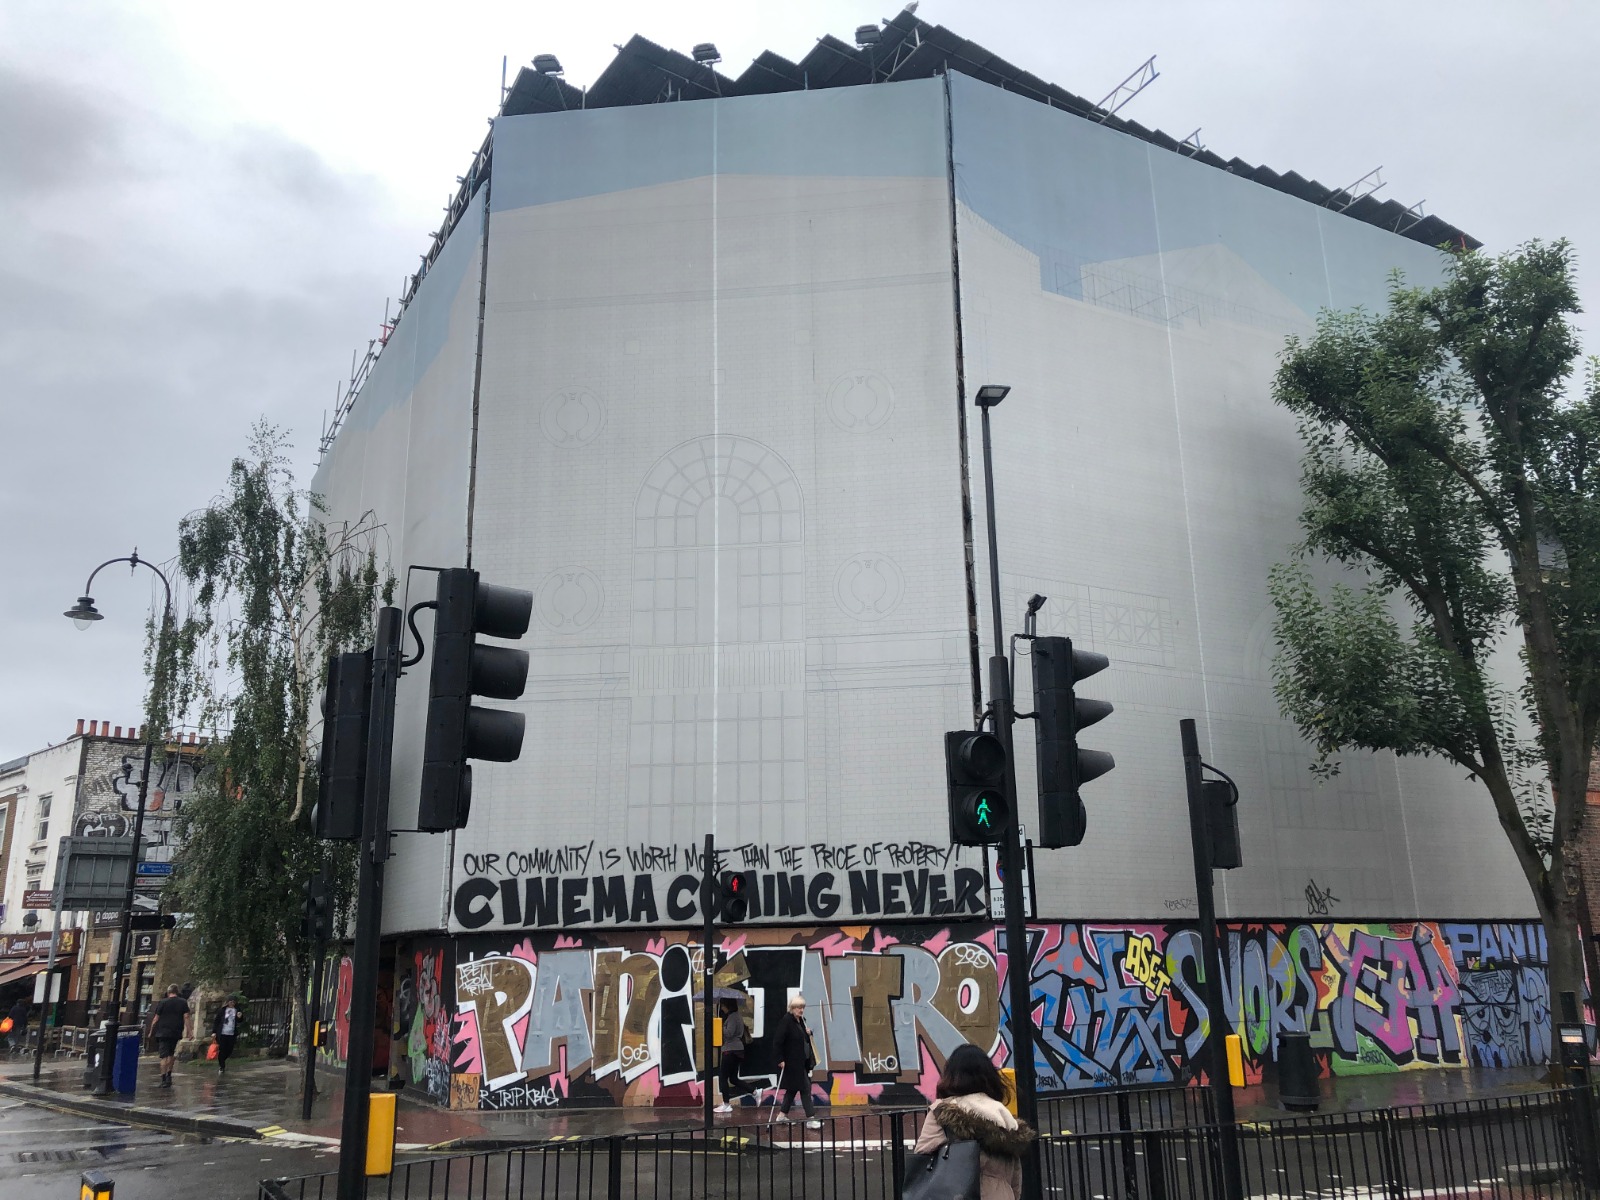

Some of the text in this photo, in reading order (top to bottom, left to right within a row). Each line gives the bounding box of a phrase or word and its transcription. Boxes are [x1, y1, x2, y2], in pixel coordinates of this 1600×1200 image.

[463, 852, 502, 876] OUR
[506, 840, 594, 877] COMMUNITY
[599, 848, 621, 871] IS
[626, 843, 677, 872] WORTH
[685, 843, 730, 873] MOE
[734, 843, 770, 870] THAN
[774, 846, 806, 871] THE
[811, 843, 861, 870] PRICE
[863, 842, 883, 866] OF
[454, 874, 659, 929] CINEMA
[848, 867, 986, 917] NEVER
[102, 911, 119, 920] doppio
[1126, 936, 1172, 997] ASET
[621, 1043, 650, 1067] 905
[863, 1051, 898, 1073] VEKO
